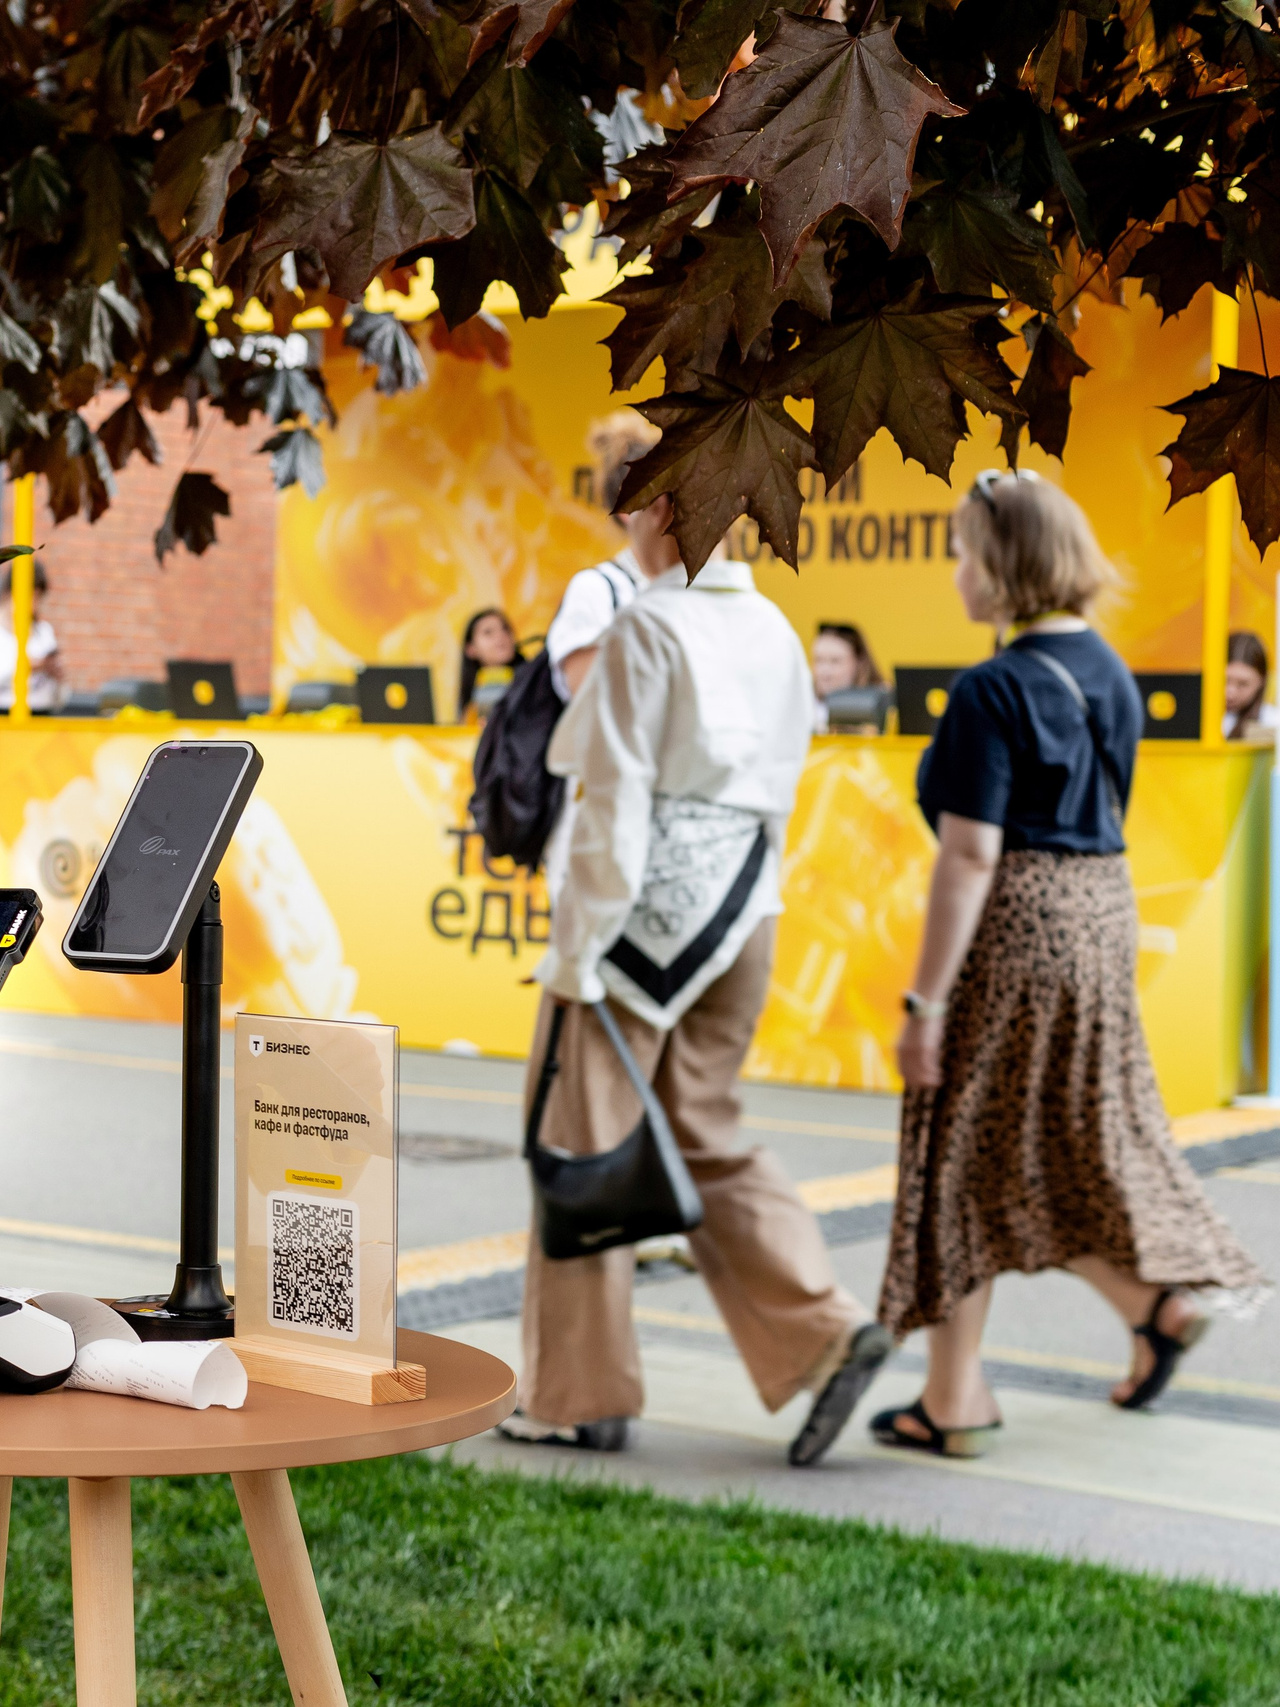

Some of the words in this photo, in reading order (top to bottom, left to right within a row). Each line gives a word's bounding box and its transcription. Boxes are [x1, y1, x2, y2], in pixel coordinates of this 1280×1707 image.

[265, 1041, 311, 1056] БИЗНЕС
[254, 1099, 280, 1115] Банк
[281, 1104, 300, 1118] для
[302, 1106, 371, 1128] ресторанов,
[254, 1118, 282, 1135] кафе
[283, 1122, 291, 1134] и
[292, 1121, 349, 1142] фастфуда
